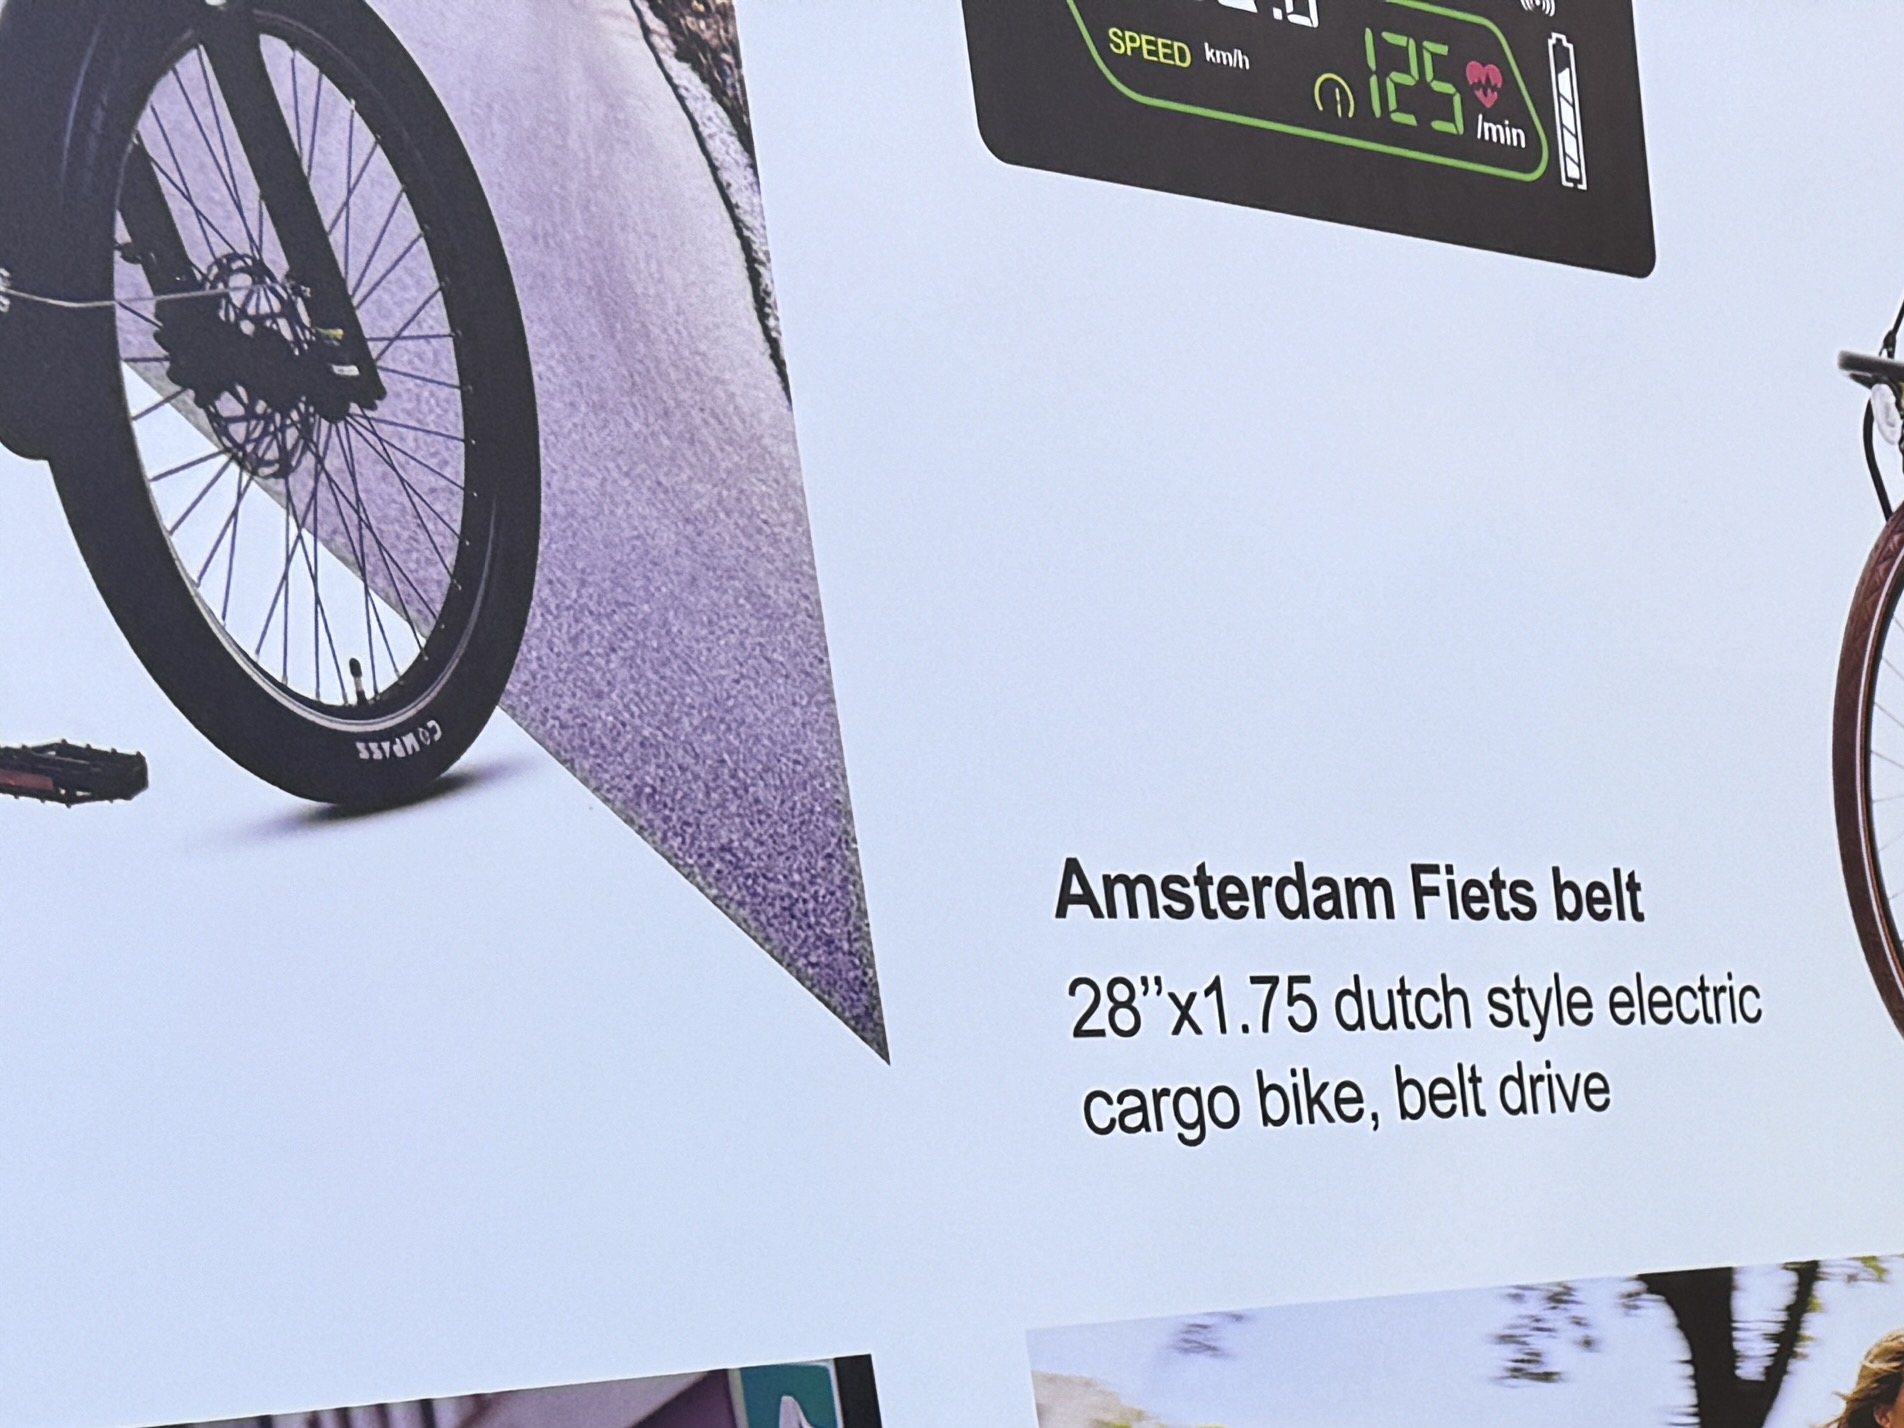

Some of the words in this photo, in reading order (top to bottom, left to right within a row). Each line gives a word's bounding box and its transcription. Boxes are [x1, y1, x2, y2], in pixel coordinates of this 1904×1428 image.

[1108, 27, 1191, 68] SPEED
[1205, 42, 1250, 72] km/h
[1364, 27, 1464, 135] 125
[1477, 115, 1526, 148] /min
[356, 719, 443, 760] COMPASS
[1055, 858, 1395, 920] Amsterdam
[1411, 864, 1538, 921] Fiets
[1553, 867, 1645, 922] belt
[1335, 973, 1471, 1031] dutch
[1489, 973, 1592, 1041] style
[1609, 972, 1762, 1025] electric
[1083, 1086, 1240, 1146] cargo
[1258, 1069, 1379, 1131] bike,
[1395, 1062, 1486, 1120] belt
[1499, 1059, 1610, 1115] drive
